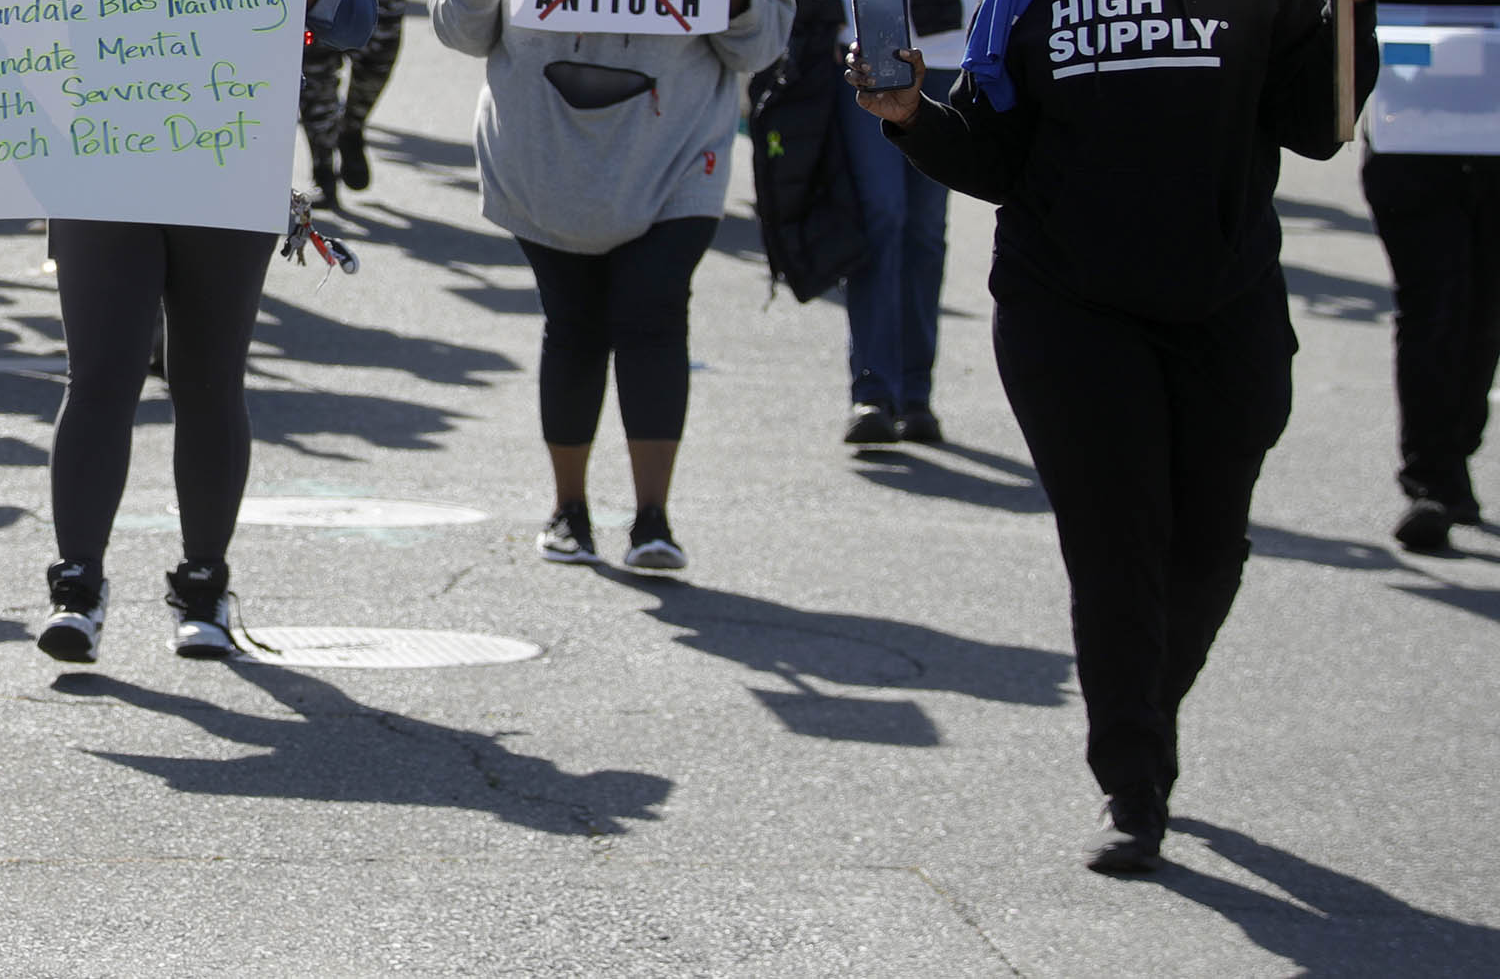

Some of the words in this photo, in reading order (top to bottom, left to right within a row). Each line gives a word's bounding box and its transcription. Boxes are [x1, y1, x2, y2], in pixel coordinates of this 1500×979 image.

[99, 31, 202, 67] Mental
[62, 76, 192, 109] Services
[203, 61, 271, 103] for
[69, 117, 160, 158] Police
